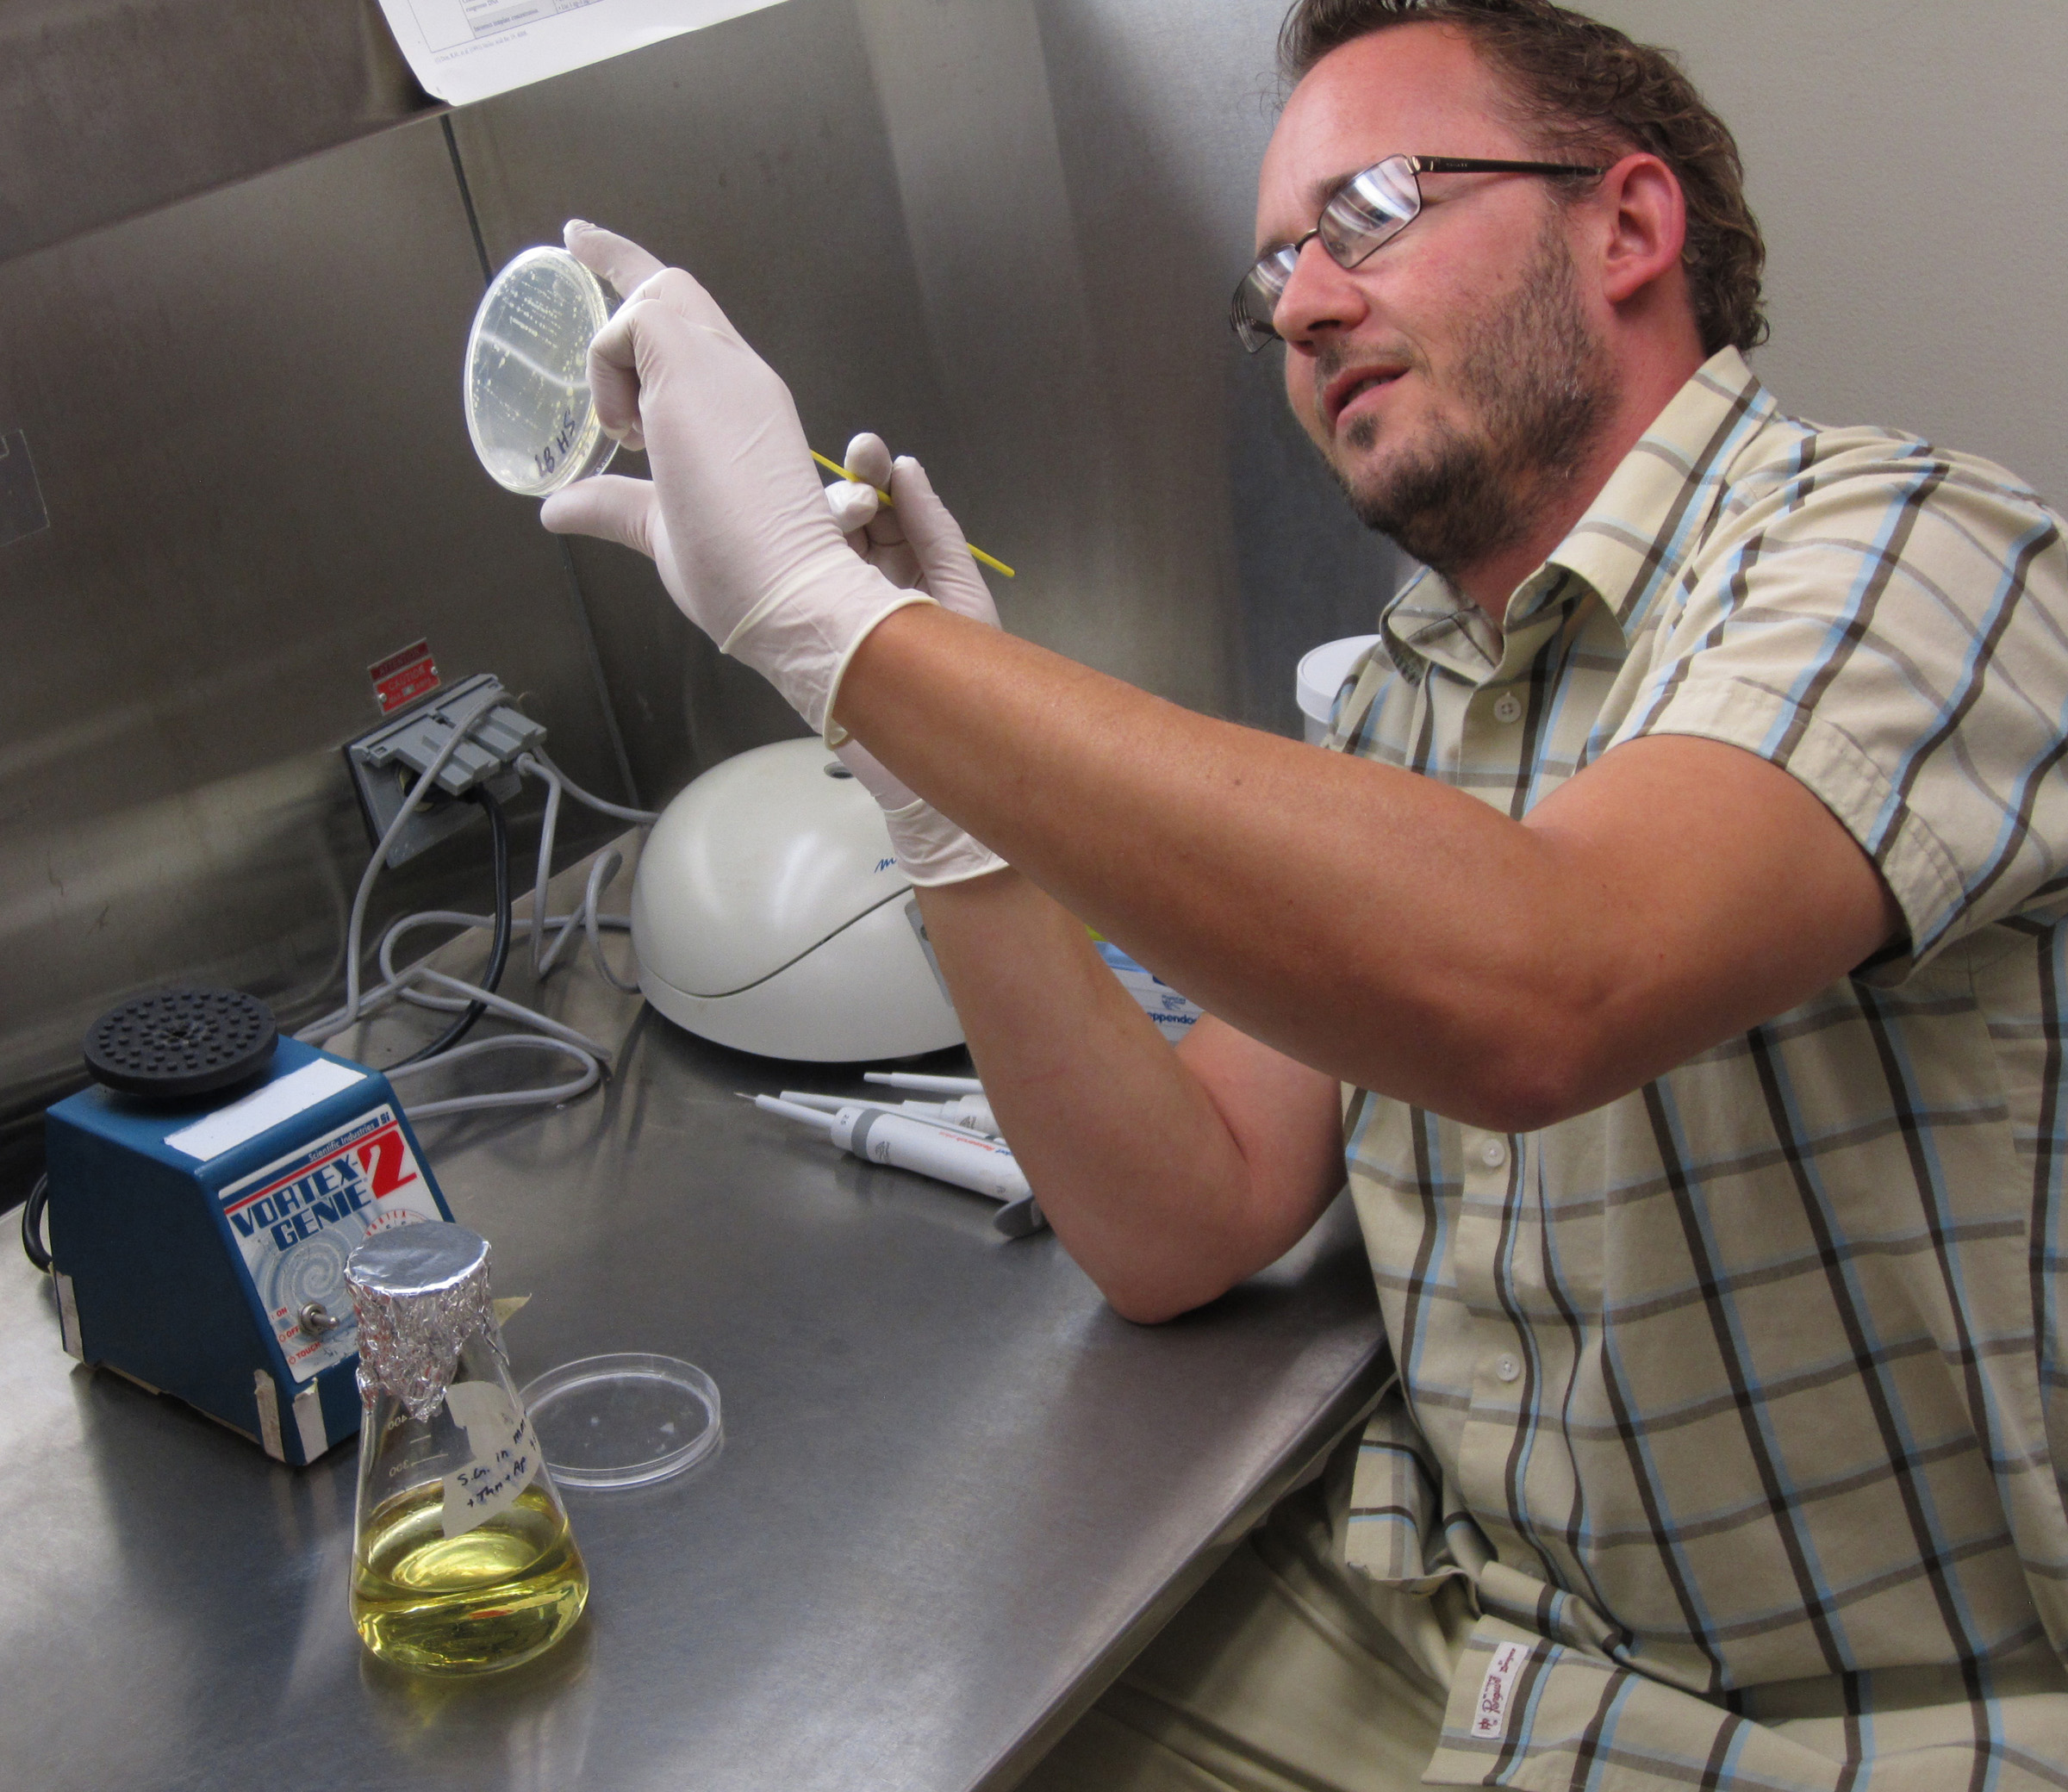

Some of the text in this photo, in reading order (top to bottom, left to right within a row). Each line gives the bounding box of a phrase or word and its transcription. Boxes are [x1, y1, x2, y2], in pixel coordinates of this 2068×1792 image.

[308, 1140, 340, 1162] Scientific
[340, 1123, 376, 1145] Industries
[357, 1129, 417, 1199] 2
[270, 1178, 372, 1252] GENIE
[276, 1307, 288, 1318] ON
[285, 1325, 300, 1338] OFF
[295, 1341, 321, 1360] TOUCH
